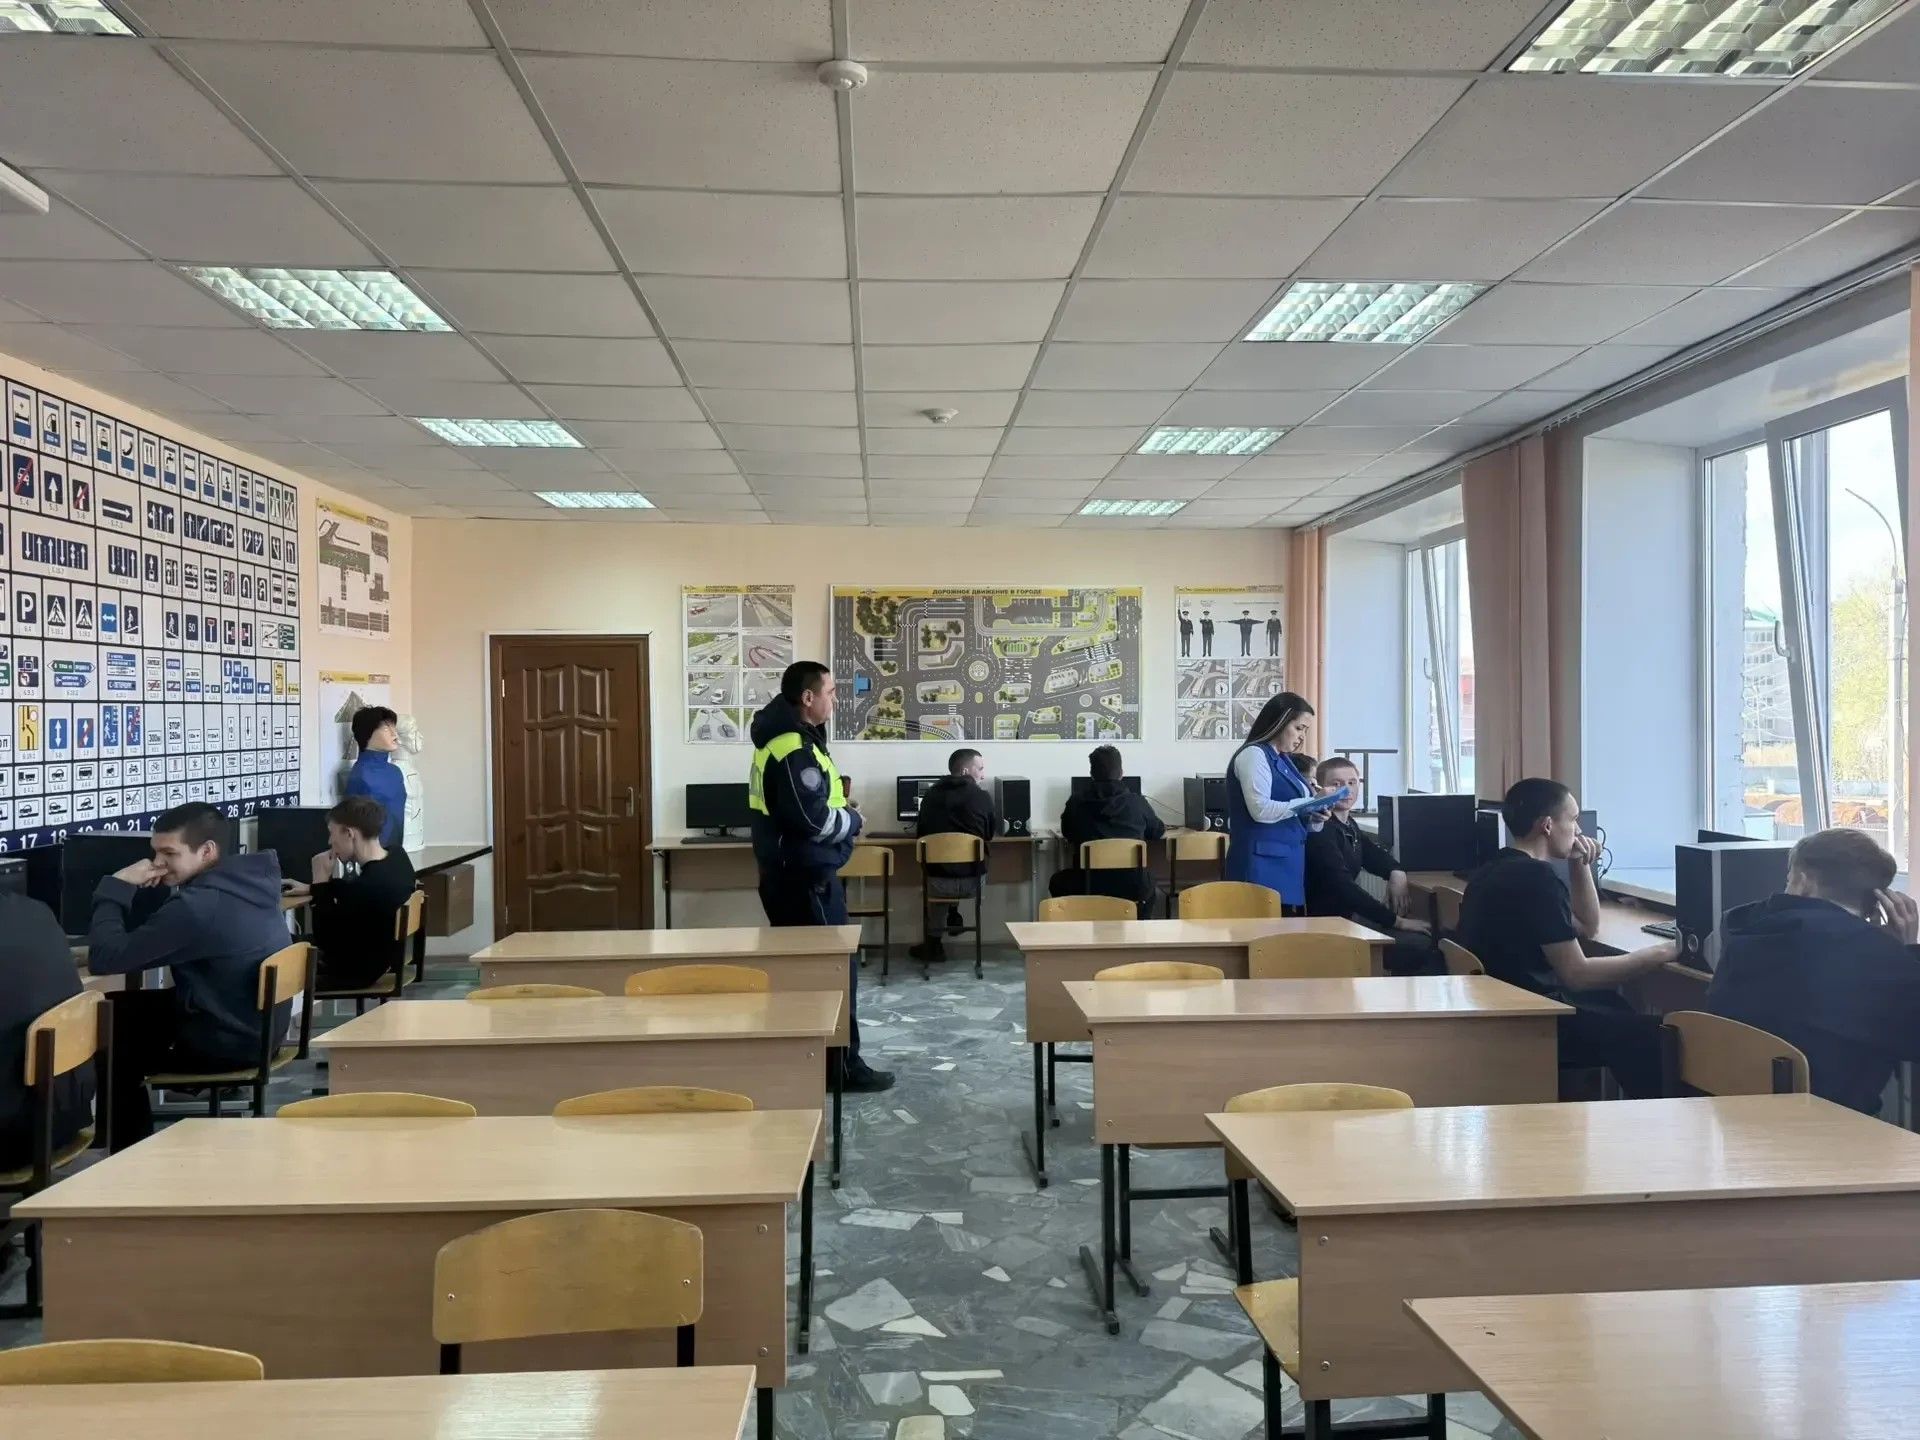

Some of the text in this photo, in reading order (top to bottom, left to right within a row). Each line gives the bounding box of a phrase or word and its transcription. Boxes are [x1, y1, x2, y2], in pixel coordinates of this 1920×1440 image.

[188, 622, 196, 632] 50
[20, 833, 38, 849] 17
[127, 819, 140, 831] 21
[227, 804, 239, 818] 26
[244, 802, 255, 815] 27
